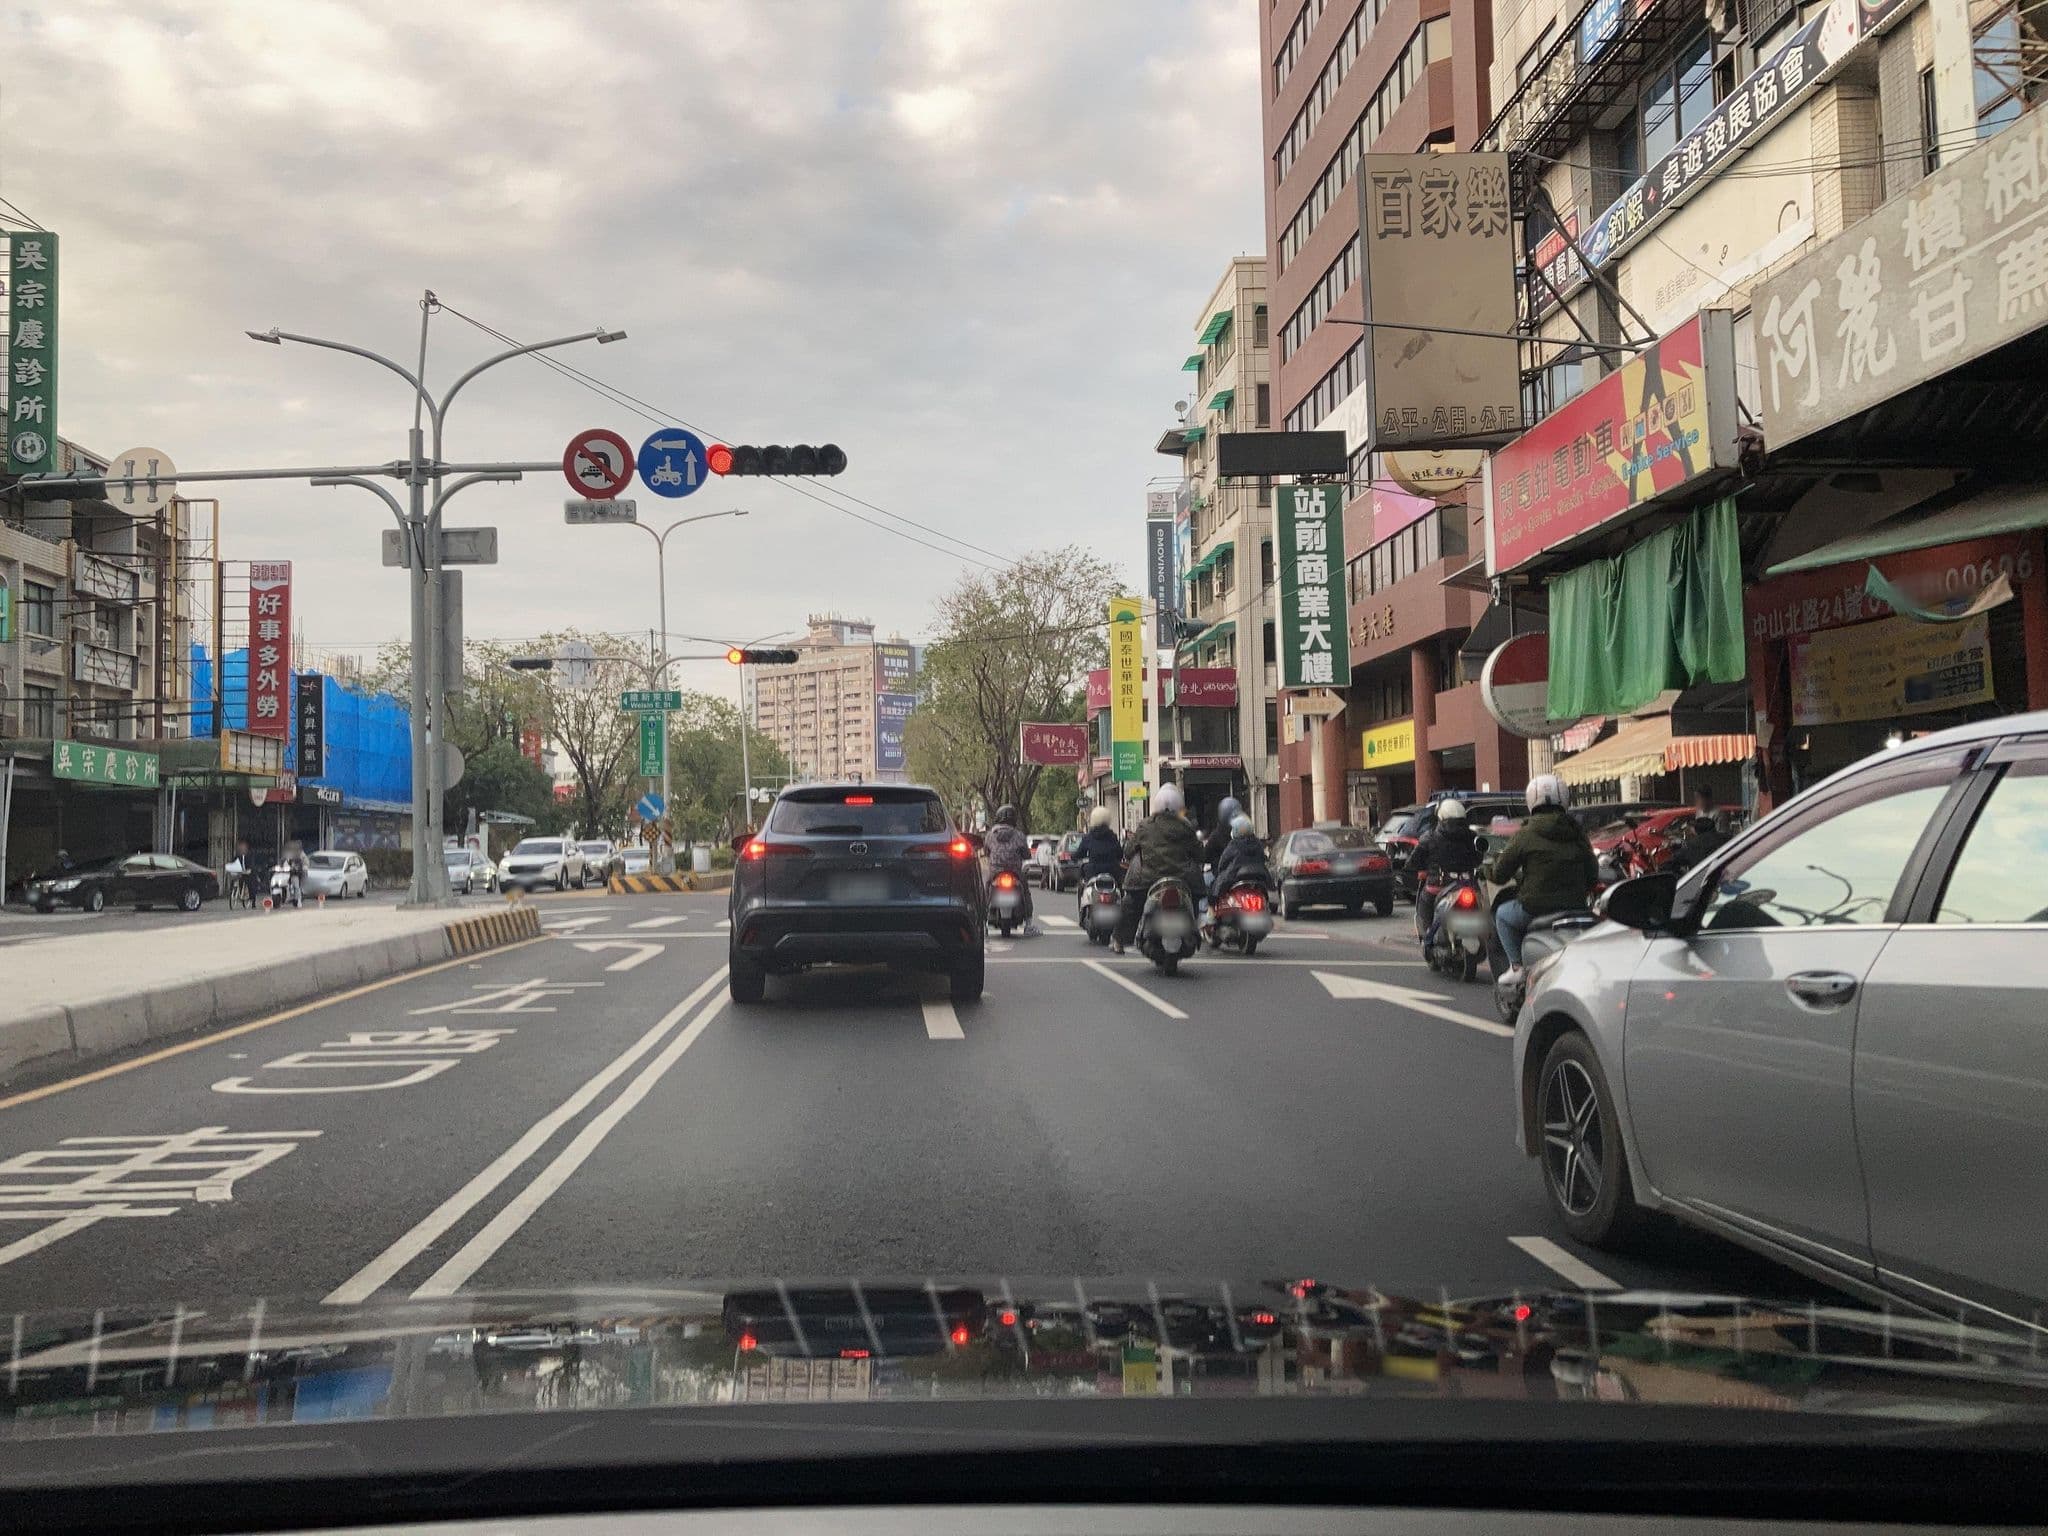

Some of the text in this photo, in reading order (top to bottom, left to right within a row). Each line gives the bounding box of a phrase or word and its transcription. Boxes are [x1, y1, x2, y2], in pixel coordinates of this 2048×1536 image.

[1661, 44, 1805, 197] 桌遊發展協會
[1371, 167, 1511, 239] 百家樂
[12, 240, 48, 424] 吳宗慶診所
[1157, 528, 1165, 583] eMOVING
[1293, 488, 1334, 684] 站前商業大樓
[257, 593, 282, 718] 好事多外勞
[1119, 630, 1133, 709] 國泰世華銀行
[57, 744, 157, 784] 吳宗慶診所
